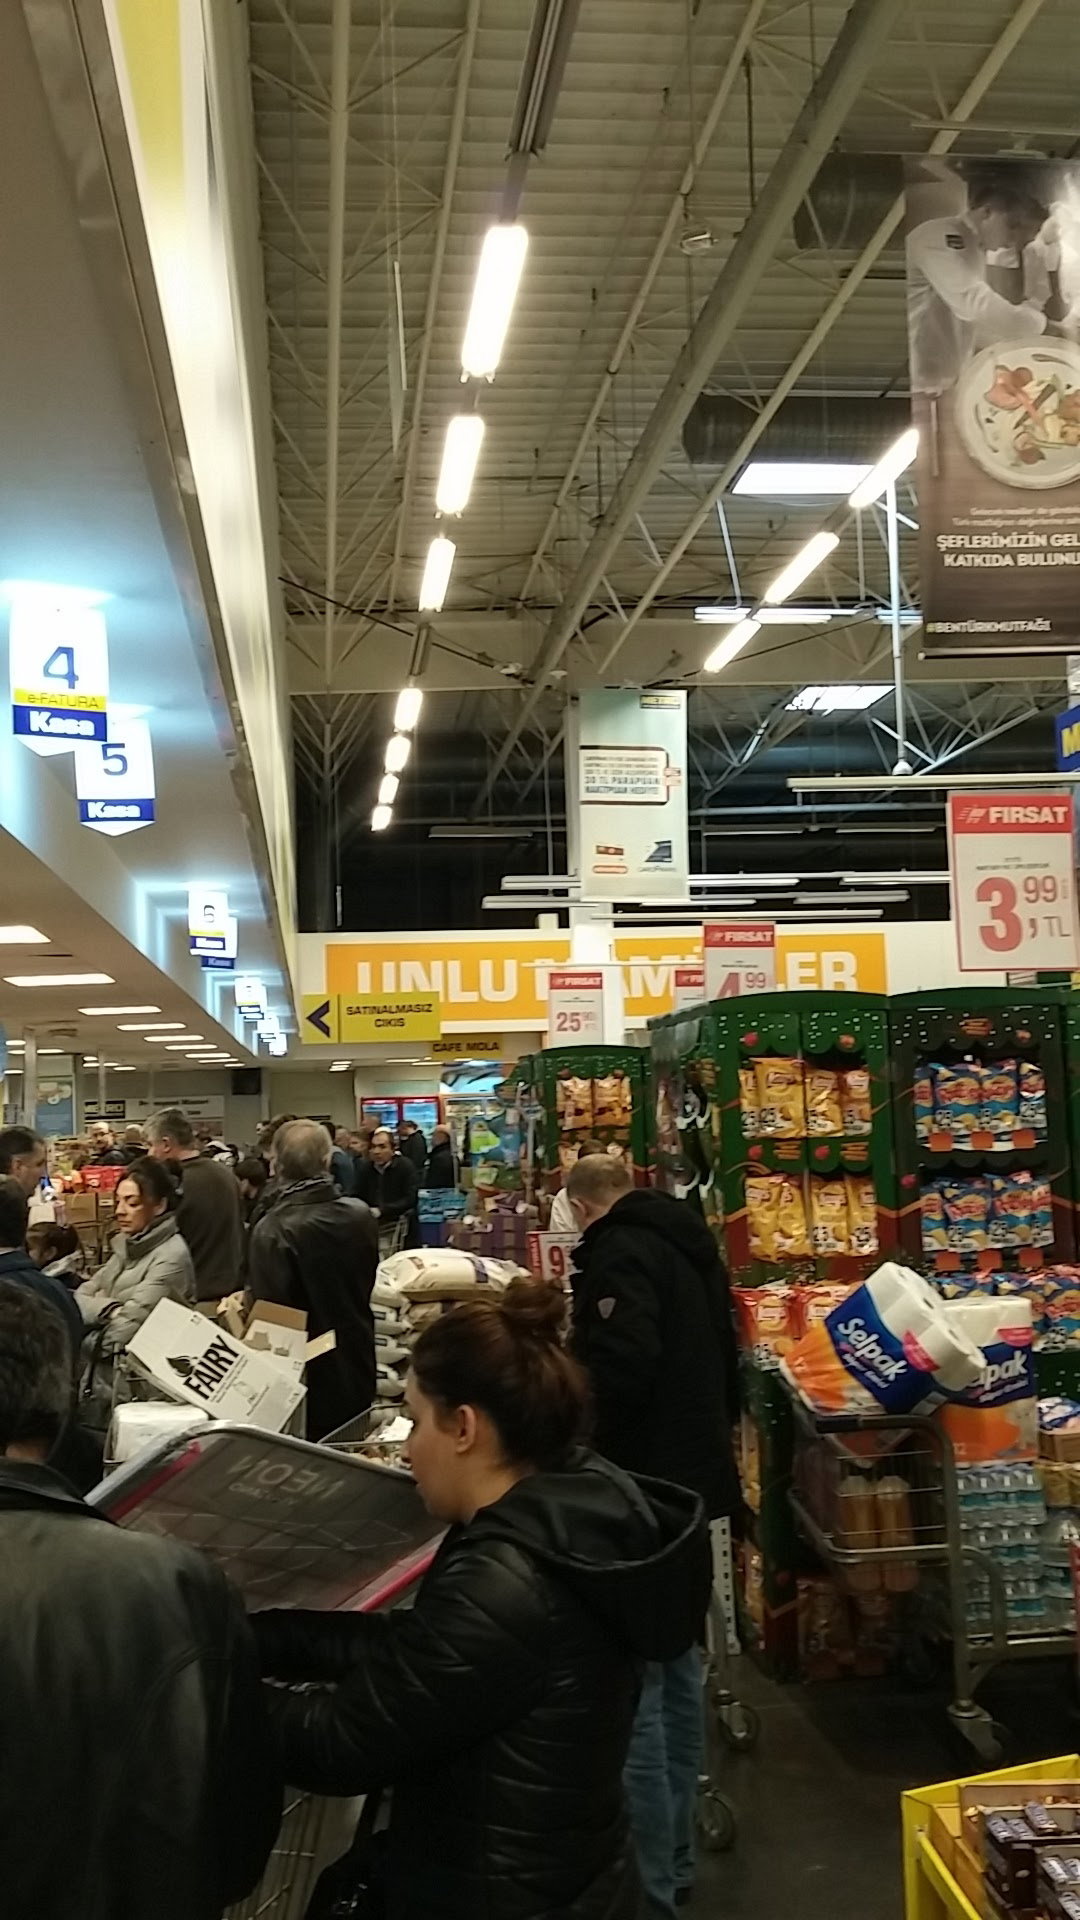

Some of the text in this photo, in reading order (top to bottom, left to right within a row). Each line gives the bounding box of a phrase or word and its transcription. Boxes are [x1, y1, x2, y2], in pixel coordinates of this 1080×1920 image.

[944, 554, 1015, 567] KATKIDA
[43, 646, 79, 690] 4
[27, 692, 99, 710] e-FATURA
[29, 710, 96, 737] Kasa
[101, 743, 128, 776] 5
[87, 801, 141, 819] Kasa
[989, 806, 1068, 824] FIRSAT
[1023, 875, 1057, 904] 99
[724, 930, 774, 942] FIRSAT
[745, 972, 766, 989] 99
[346, 1003, 433, 1016] SATINALMASIZ
[556, 1012, 581, 1032] 25
[432, 1040, 500, 1053] CAFE MOLA
[837, 1317, 908, 1383] Selpak
[183, 1333, 240, 1401] FAIRY
